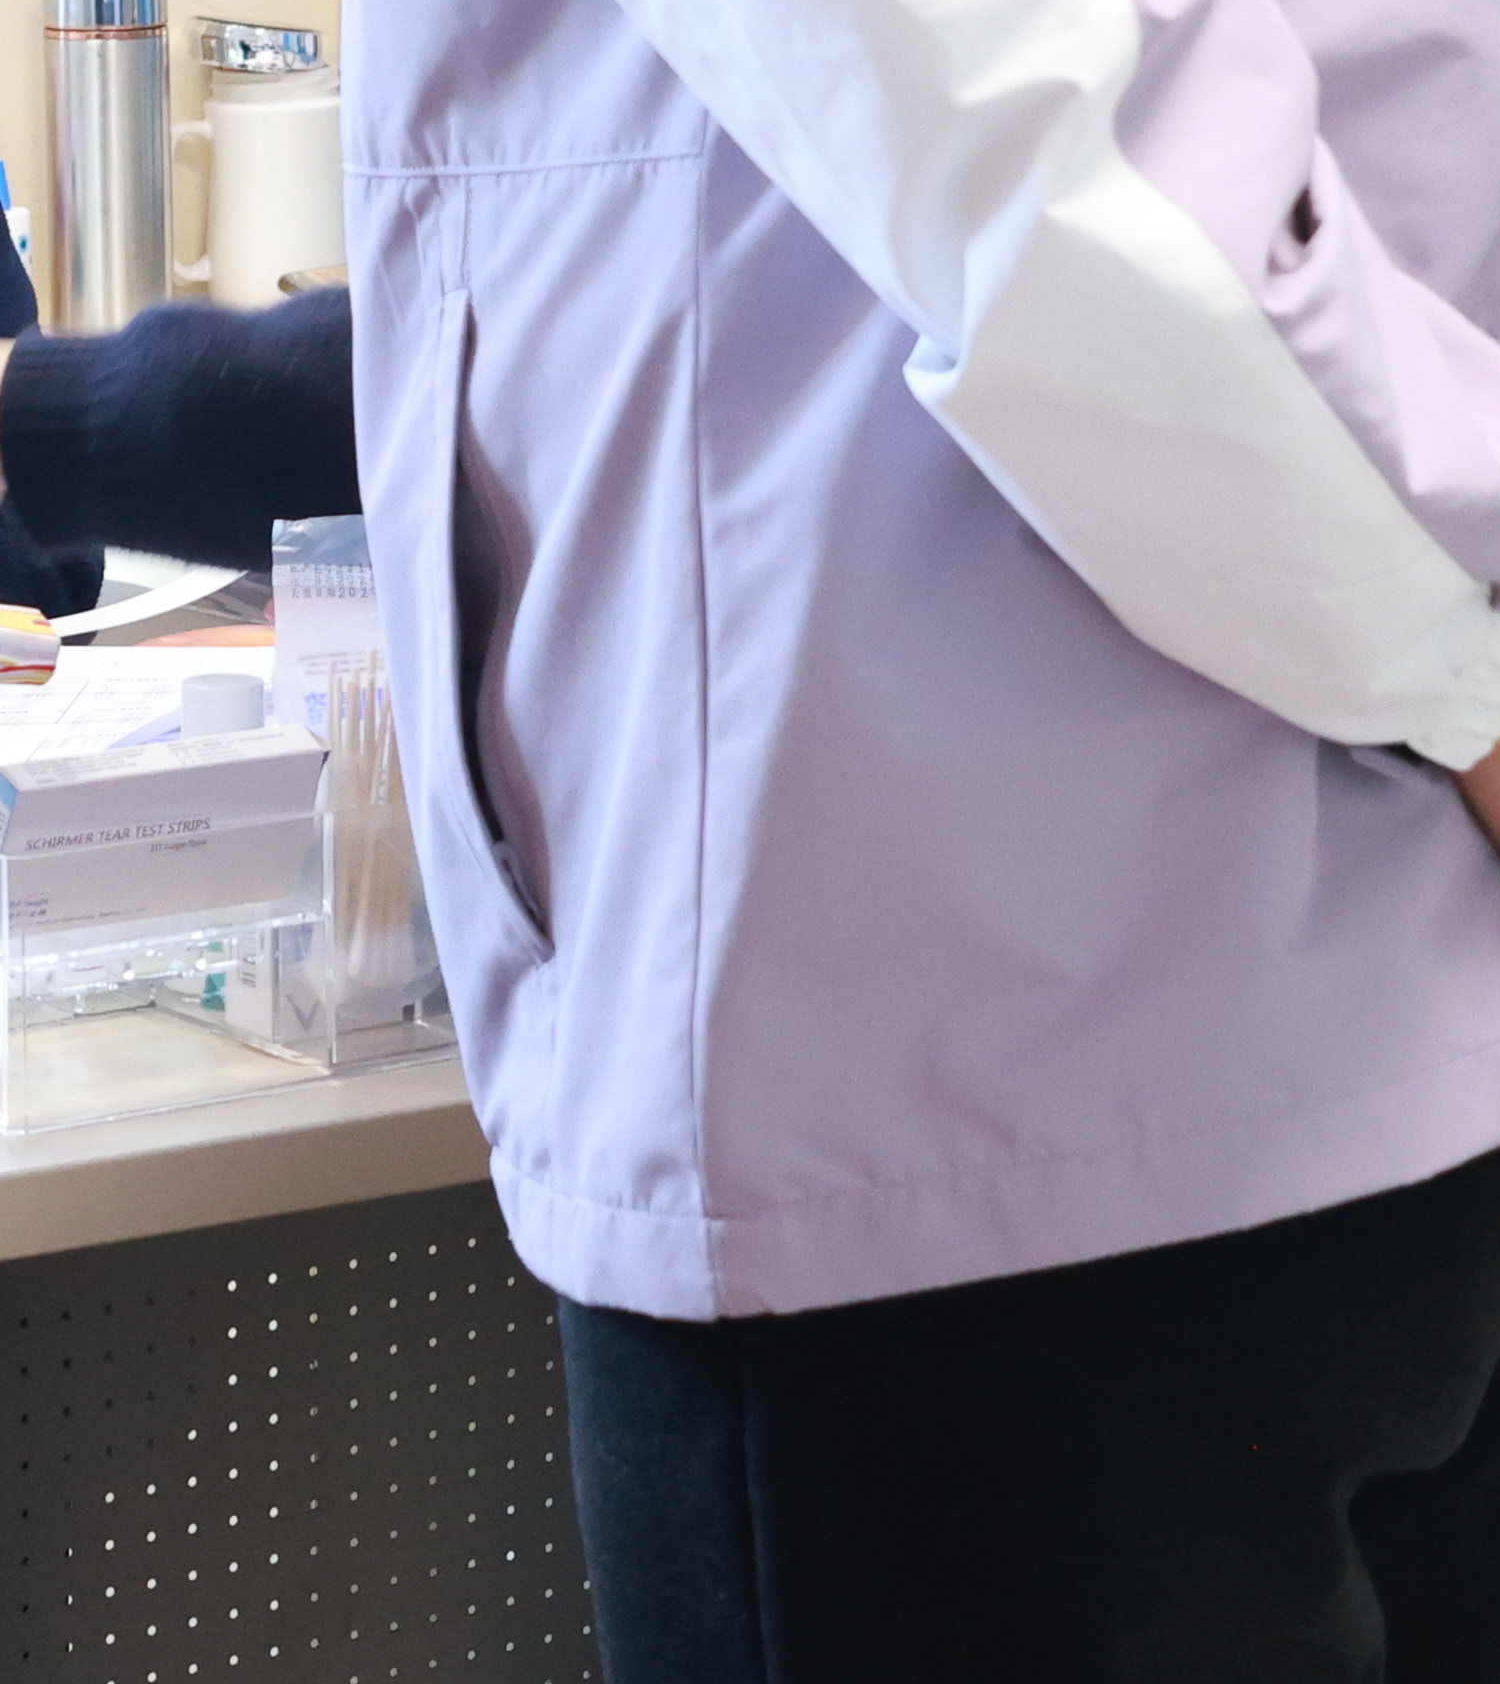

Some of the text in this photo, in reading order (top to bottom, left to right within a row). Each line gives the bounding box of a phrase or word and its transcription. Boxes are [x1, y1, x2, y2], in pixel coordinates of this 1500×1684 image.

[24, 817, 212, 852] SCHIRMER TEAR TEST STRIPS
